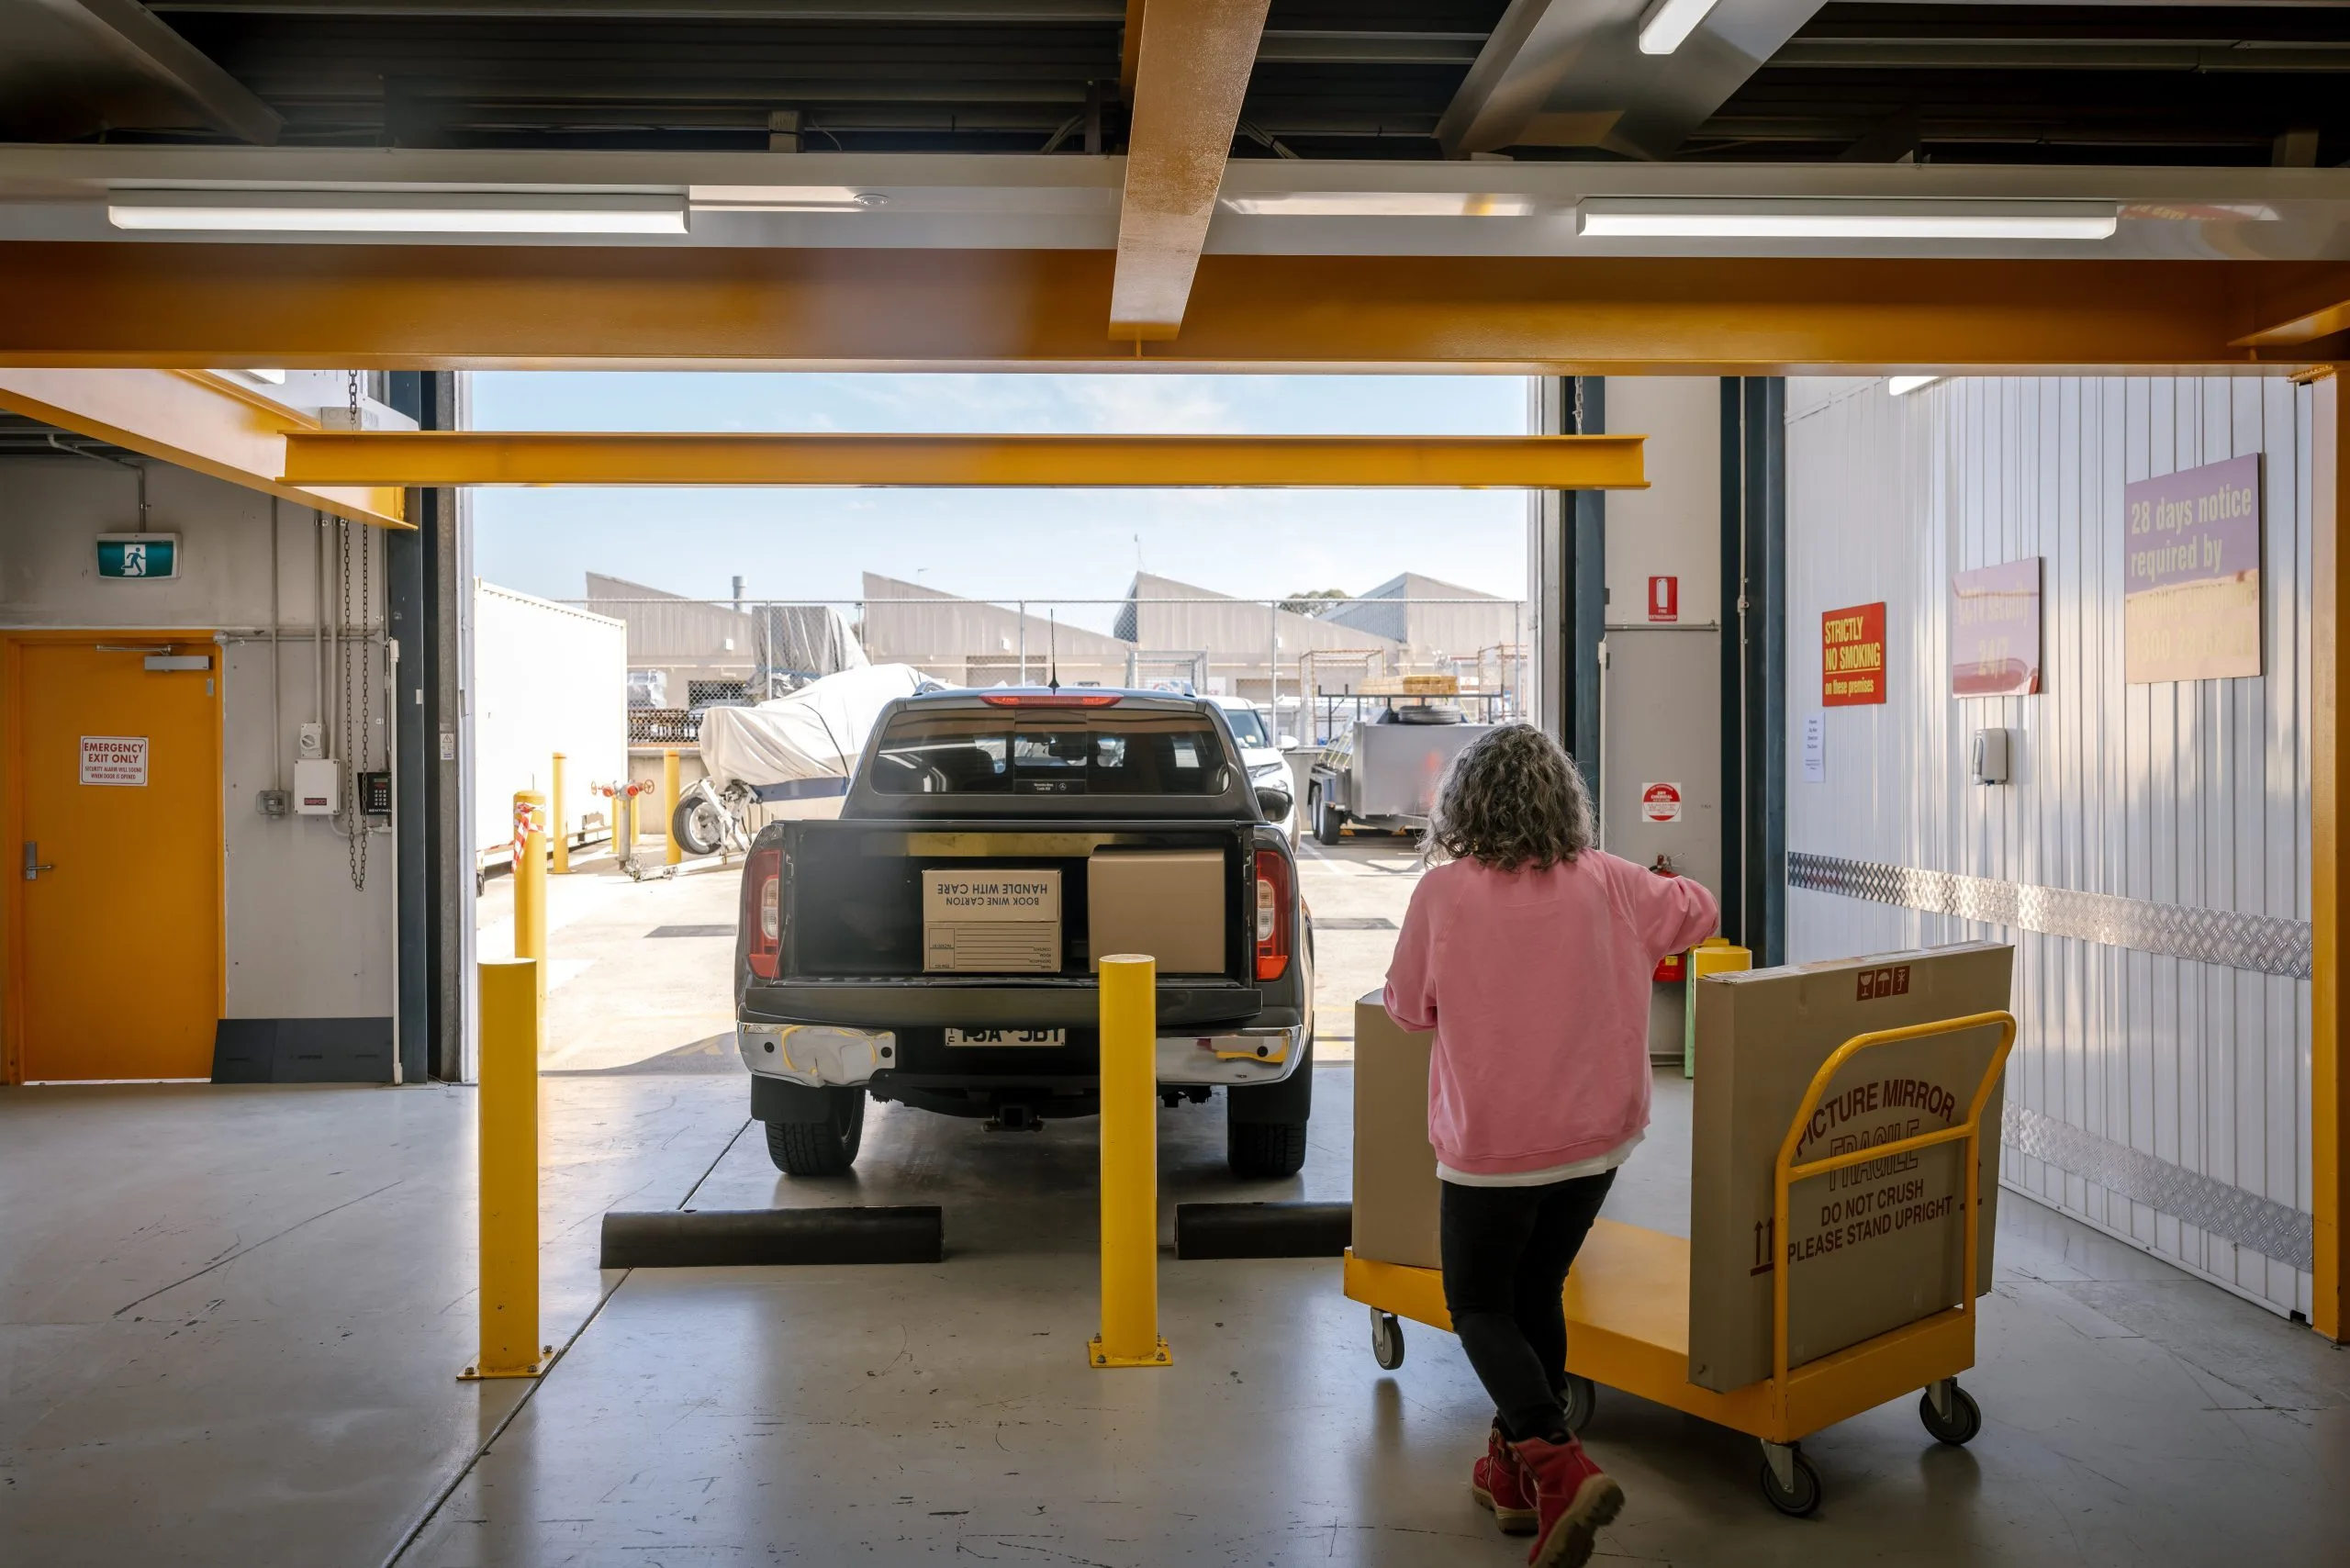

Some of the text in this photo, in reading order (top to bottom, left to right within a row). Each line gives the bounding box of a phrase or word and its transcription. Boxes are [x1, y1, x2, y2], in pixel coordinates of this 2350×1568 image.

[2132, 483, 2252, 535] 28 days notice
[2131, 533, 2222, 582] required by
[1825, 616, 1863, 644] STRICTLY
[1825, 642, 1881, 671] NO SMOKING
[1825, 676, 1874, 698] on these premises
[84, 743, 144, 753] EMERGENCY
[88, 754, 139, 764] EXIT ONLY
[937, 883, 1047, 894] HANDLE WITH CARE
[946, 897, 1039, 906] BOOK WINE CARTON
[1883, 1079, 1955, 1124] MIRROR
[1829, 1118, 1919, 1192] FRAGILE
[1821, 1179, 1924, 1226] DO NOT CRUSH
[1787, 1195, 1953, 1265] PLEASE STAND UPRIGHT
